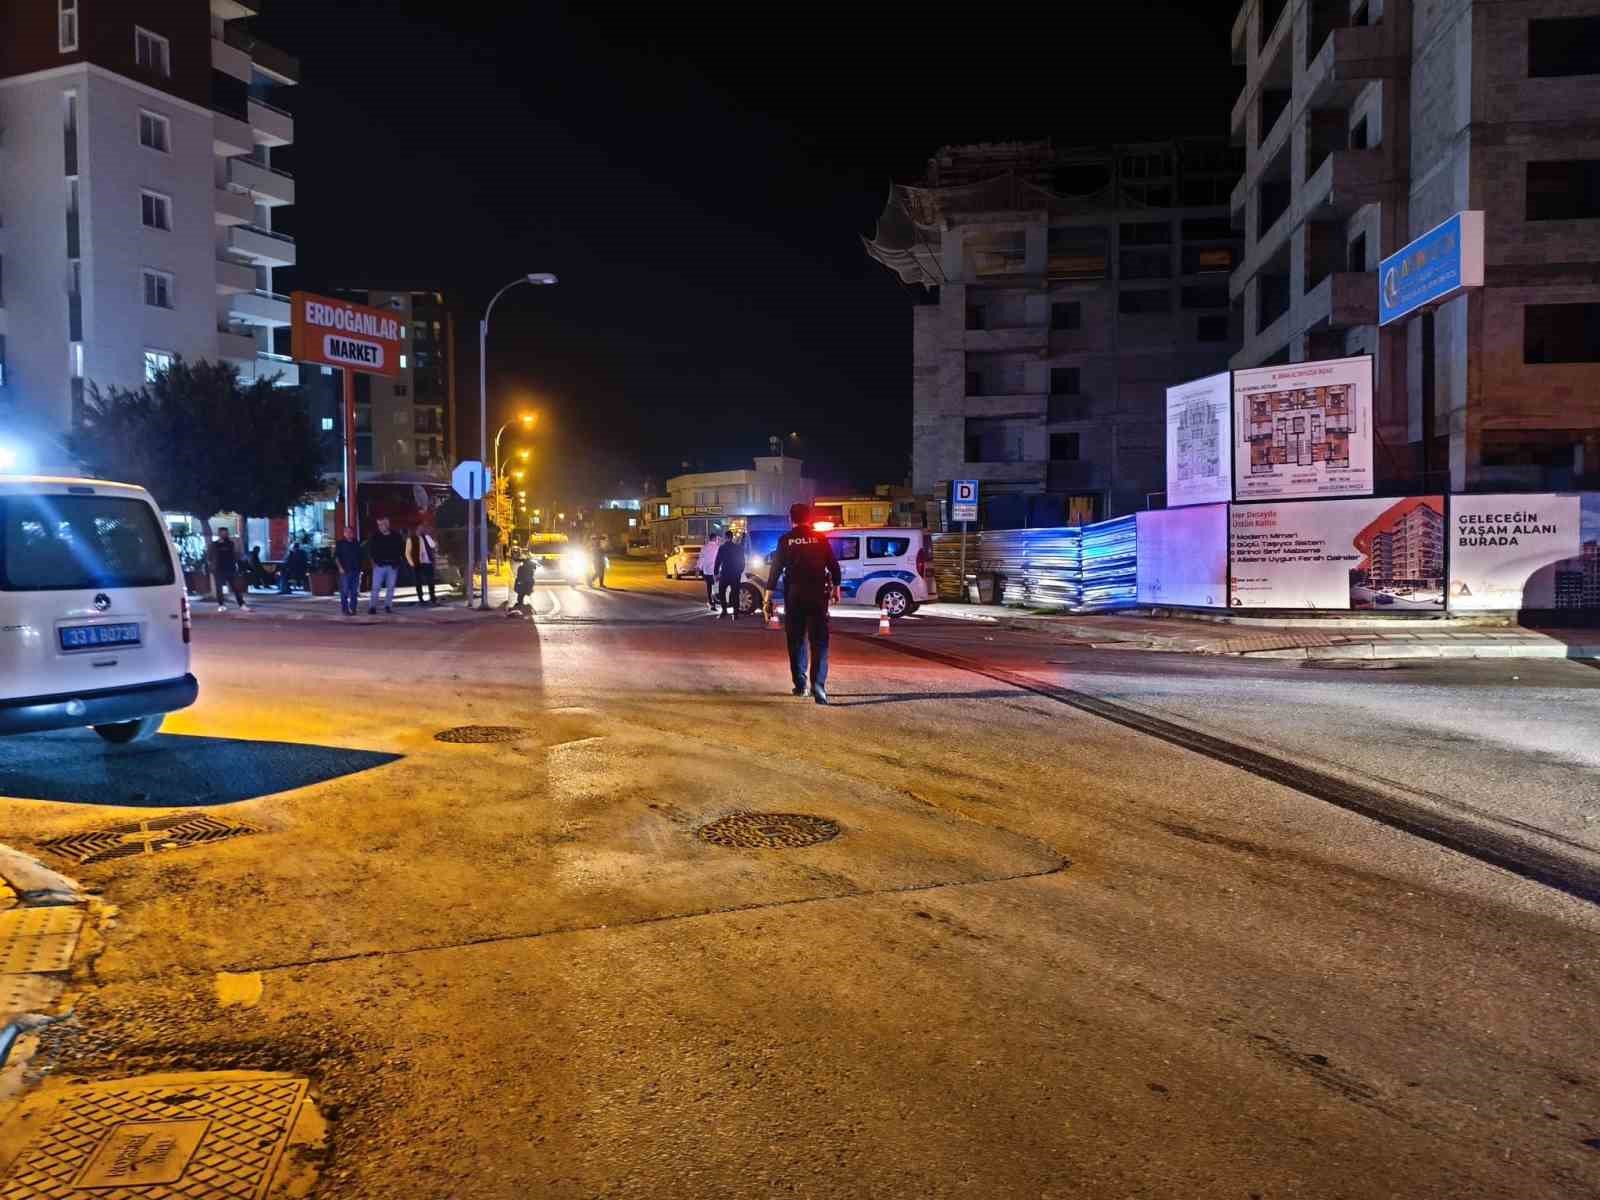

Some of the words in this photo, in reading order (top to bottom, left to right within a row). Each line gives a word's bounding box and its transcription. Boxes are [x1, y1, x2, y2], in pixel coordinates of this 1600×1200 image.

[305, 300, 398, 341] ERDOĞANLAR
[329, 338, 378, 363] MARKET
[960, 486, 971, 498] D
[1459, 511, 1538, 524] GELECEĞİN
[1459, 525, 1508, 536] YAŞAM
[1512, 524, 1557, 534] ALANI
[1459, 536, 1519, 546] BURADA
